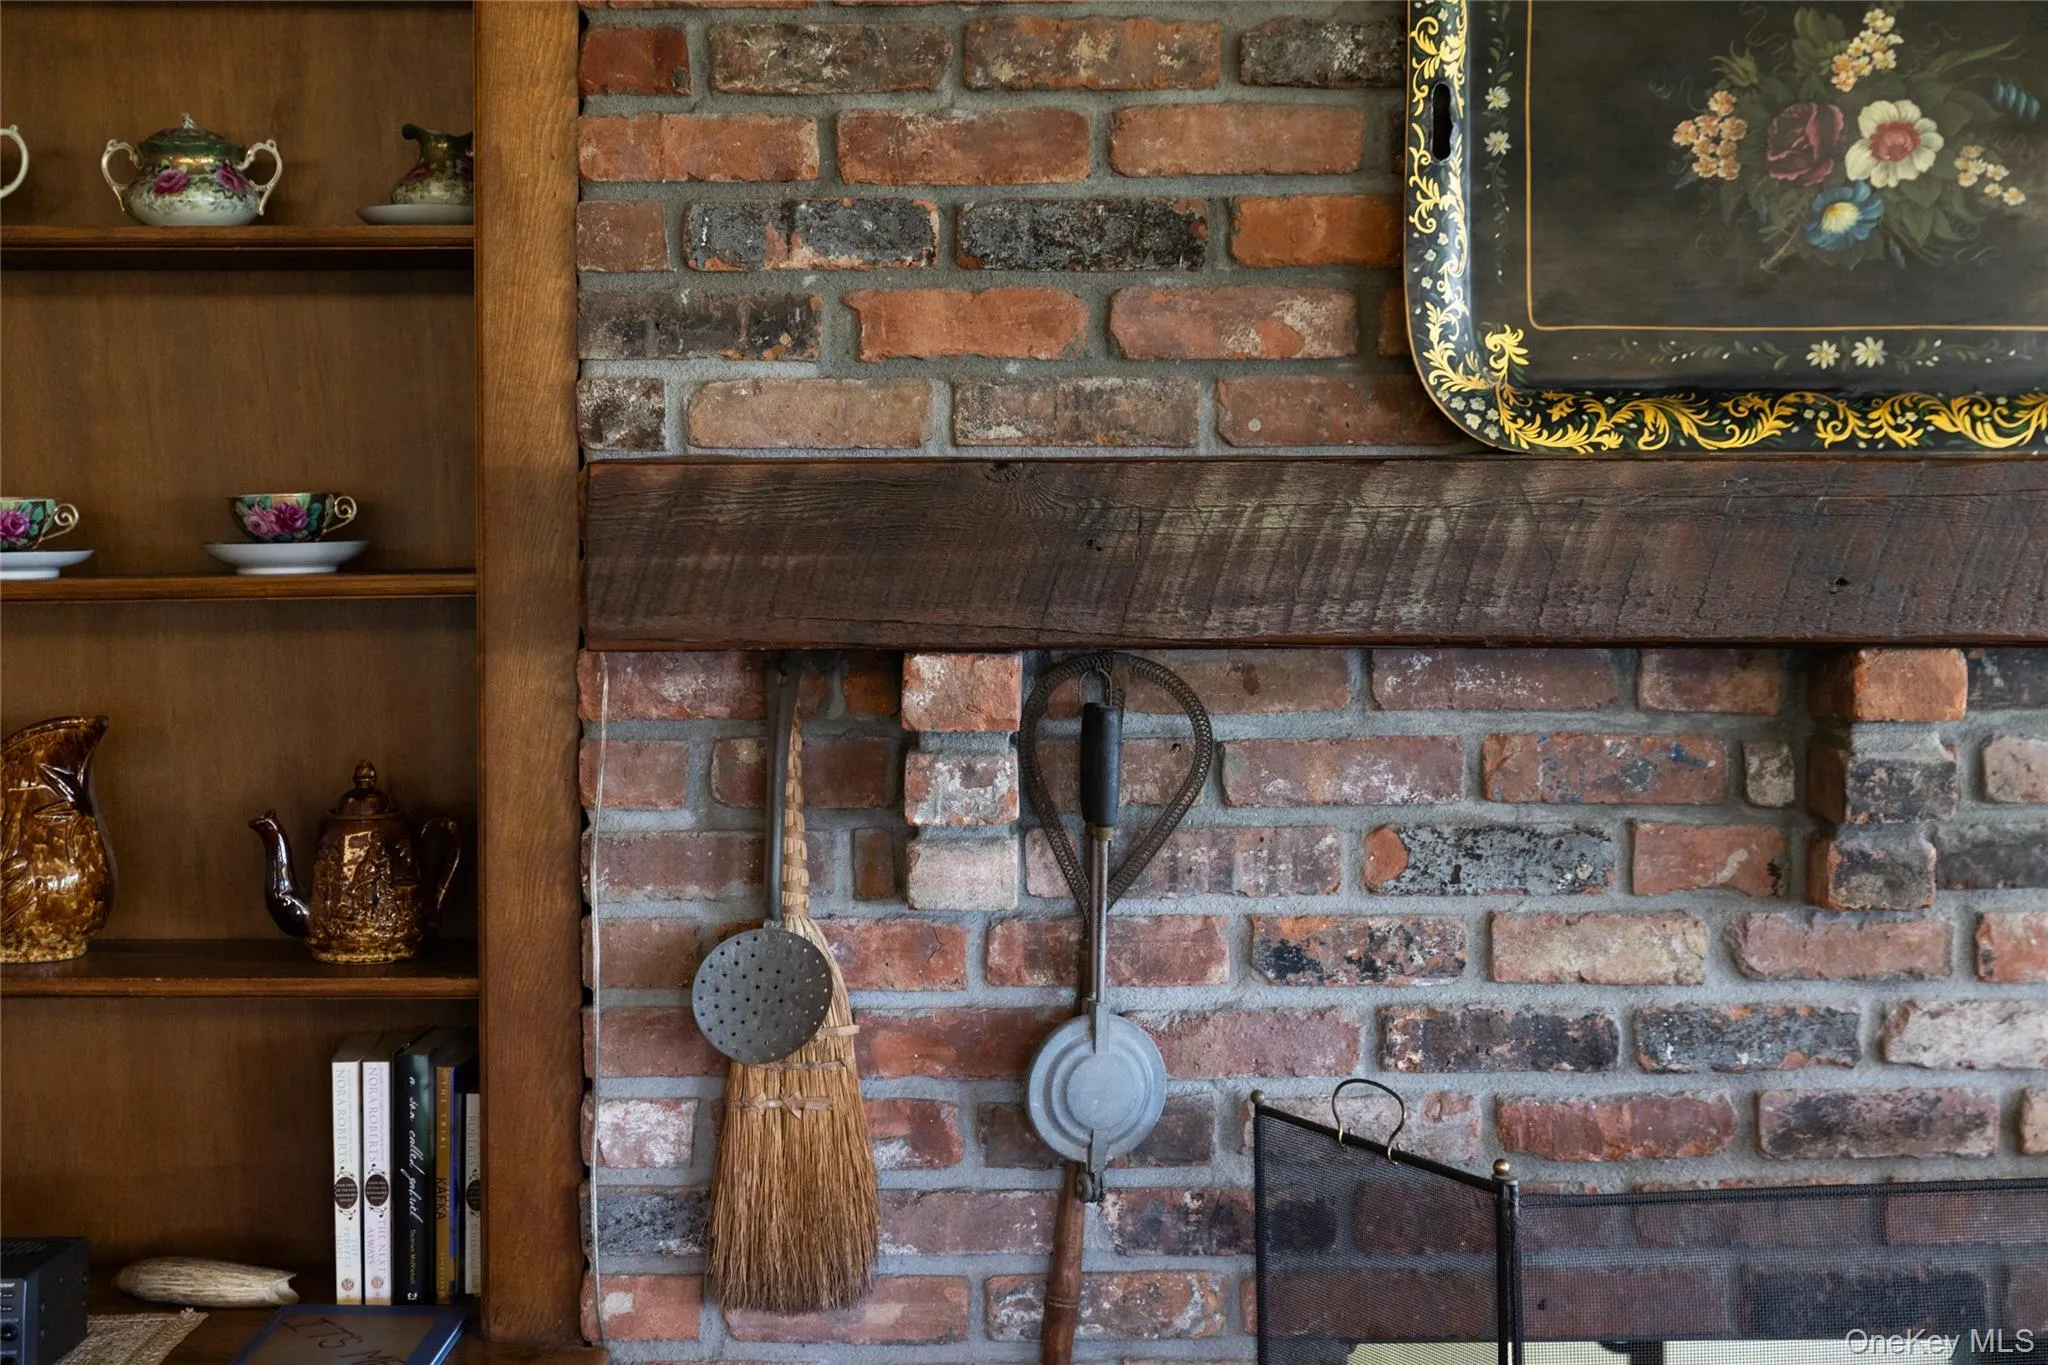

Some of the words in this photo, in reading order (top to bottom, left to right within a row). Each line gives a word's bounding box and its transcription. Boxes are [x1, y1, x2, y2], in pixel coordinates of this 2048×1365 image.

[336, 1069, 346, 1106] NORA
[368, 1067, 378, 1104] NORA
[409, 1096, 418, 1121] son
[337, 1108, 347, 1164] ROBERTS
[369, 1107, 379, 1162] ROBERTS
[409, 1130, 425, 1175] called
[400, 1167, 424, 1223] gabriel
[436, 1177, 447, 1220] KAFKA
[367, 1228, 376, 1265] ALWAYS
[378, 1219, 387, 1239] THE
[378, 1243, 387, 1274] NEXT
